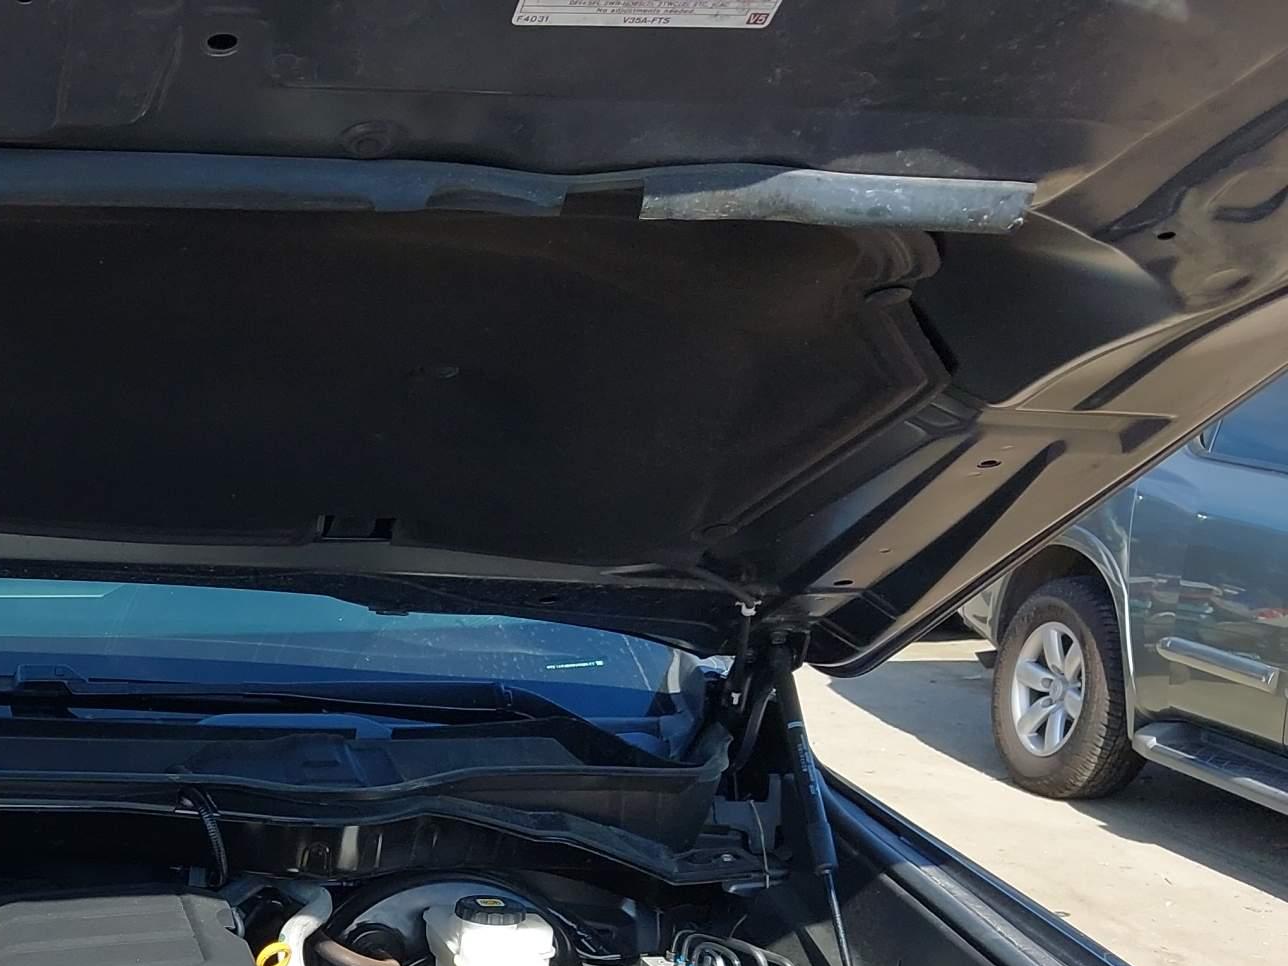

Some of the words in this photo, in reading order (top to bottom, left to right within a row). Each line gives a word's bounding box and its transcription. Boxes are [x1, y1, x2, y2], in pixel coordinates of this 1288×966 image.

[516, 15, 550, 23] F4031
[623, 16, 671, 25] V35A-FTS
[748, 13, 767, 25] V5
